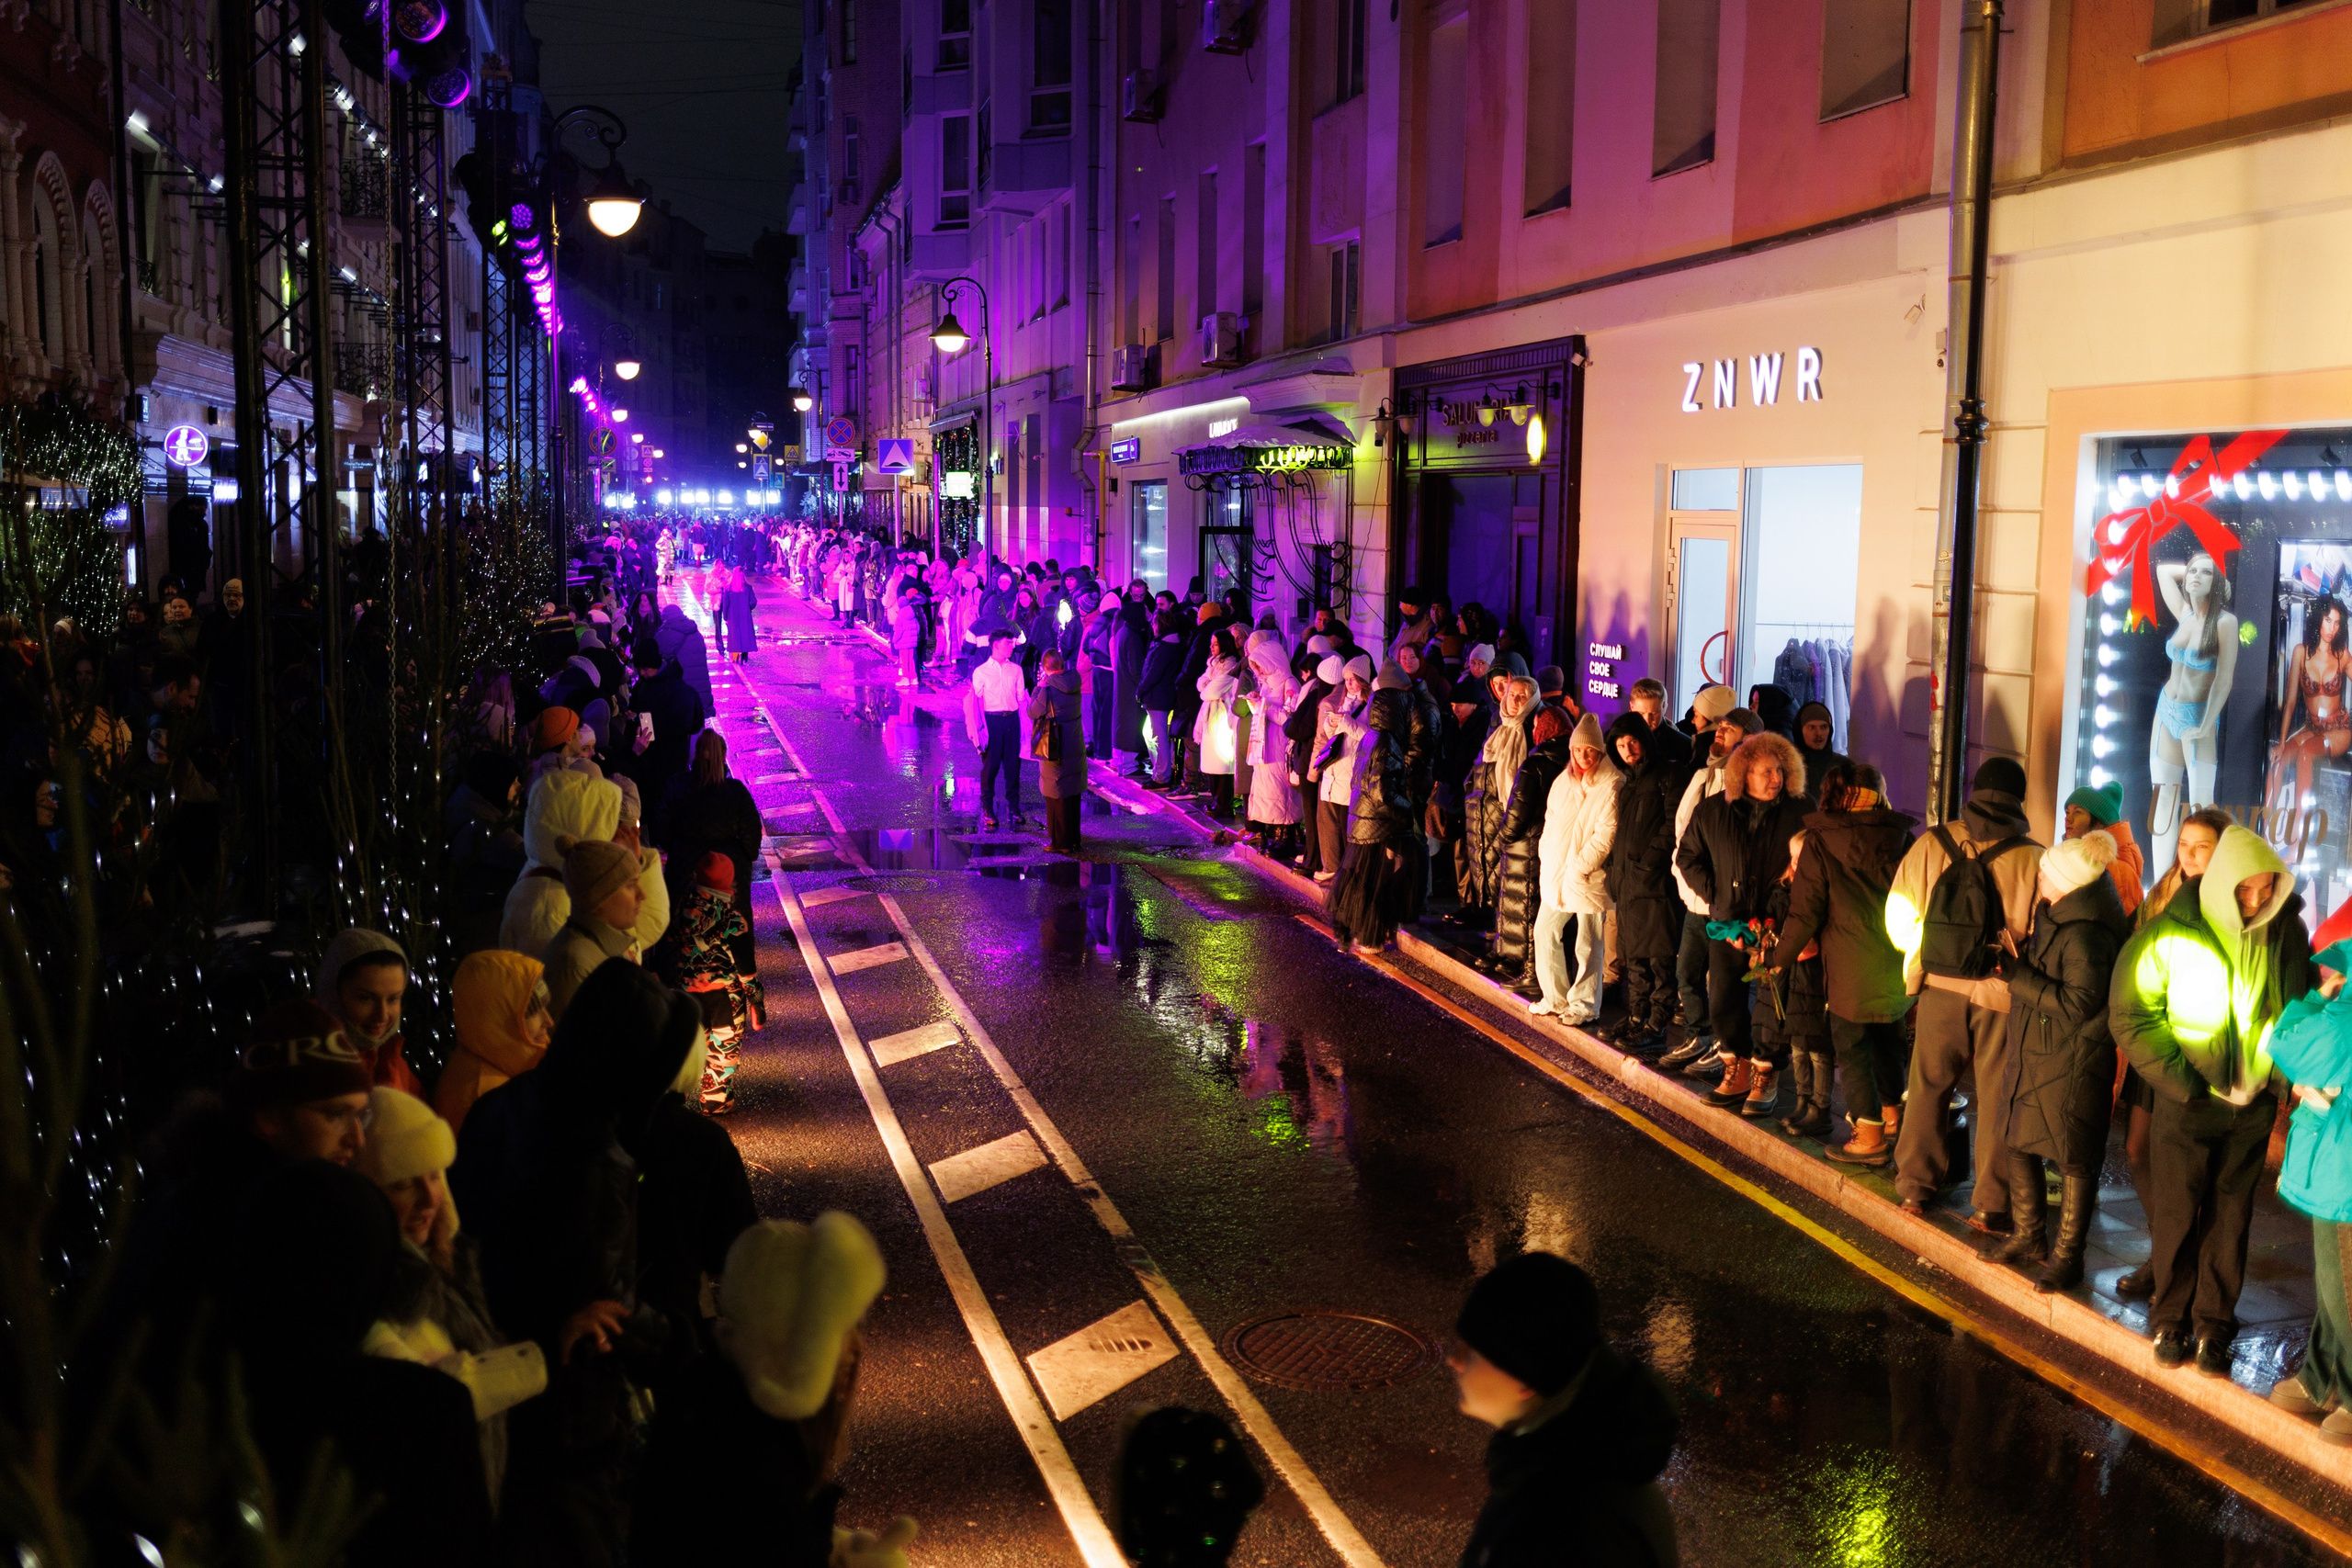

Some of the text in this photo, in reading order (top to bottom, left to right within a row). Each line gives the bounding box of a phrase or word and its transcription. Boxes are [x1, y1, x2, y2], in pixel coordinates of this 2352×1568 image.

[1681, 345, 1823, 413] ZNWR
[1442, 398, 1512, 427] SALUMRIA
[1457, 430, 1498, 448] pizzeria
[1589, 642, 1623, 660] СЛУШАЙ
[1589, 660, 1611, 678] СВОЕ
[1589, 679, 1619, 699] СЕРДЦЕ
